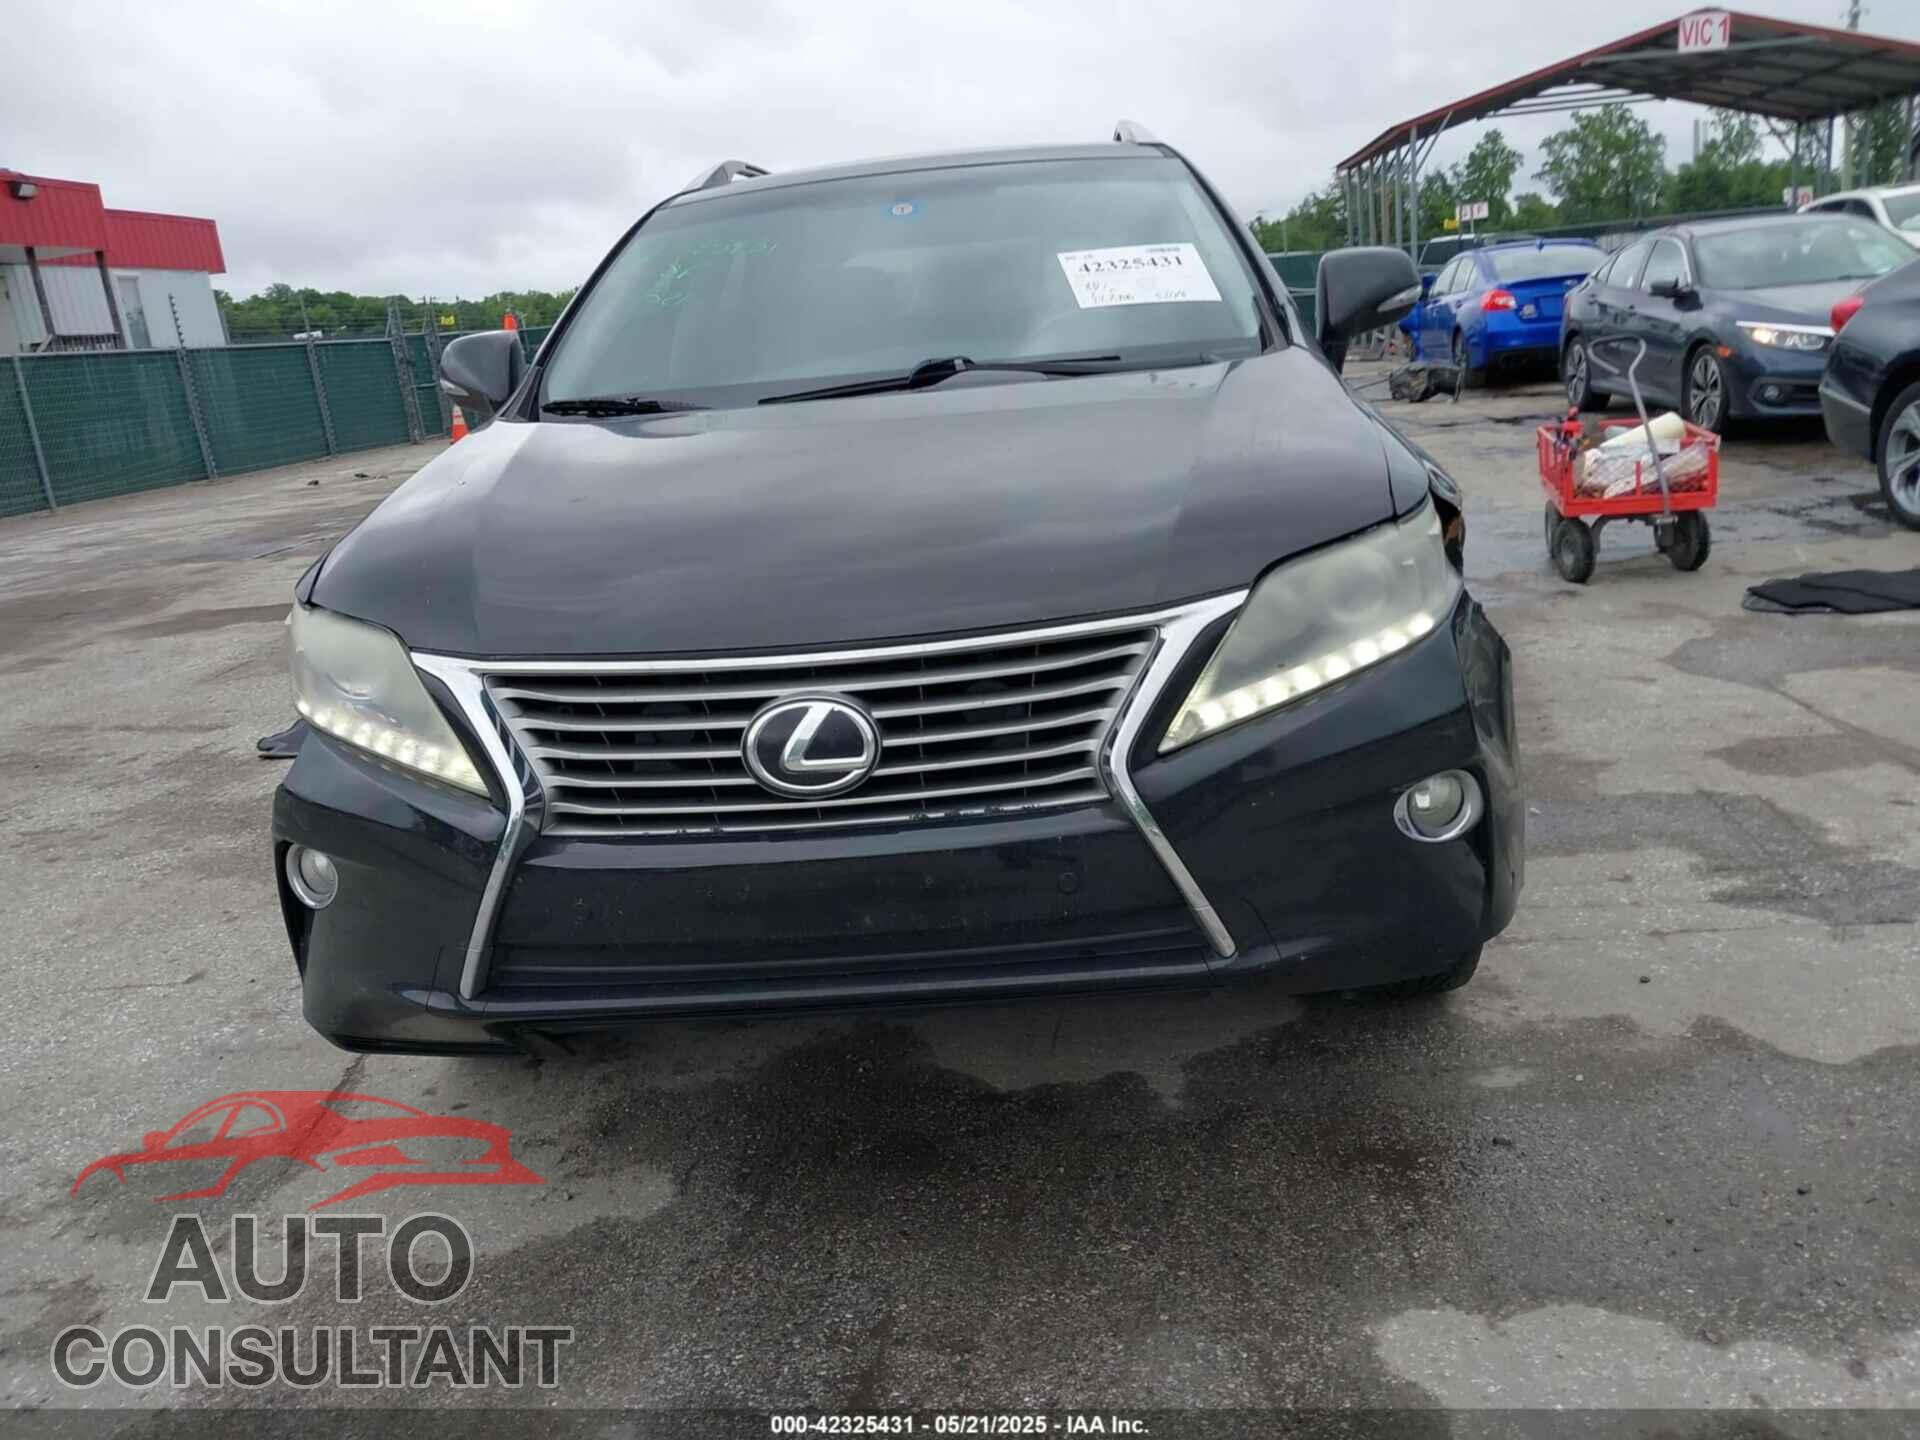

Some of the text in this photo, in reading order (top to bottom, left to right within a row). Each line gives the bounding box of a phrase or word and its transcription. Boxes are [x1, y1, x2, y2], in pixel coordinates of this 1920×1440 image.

[1682, 16, 1728, 46] VIC 1
[1079, 255, 1183, 273] 42325431
